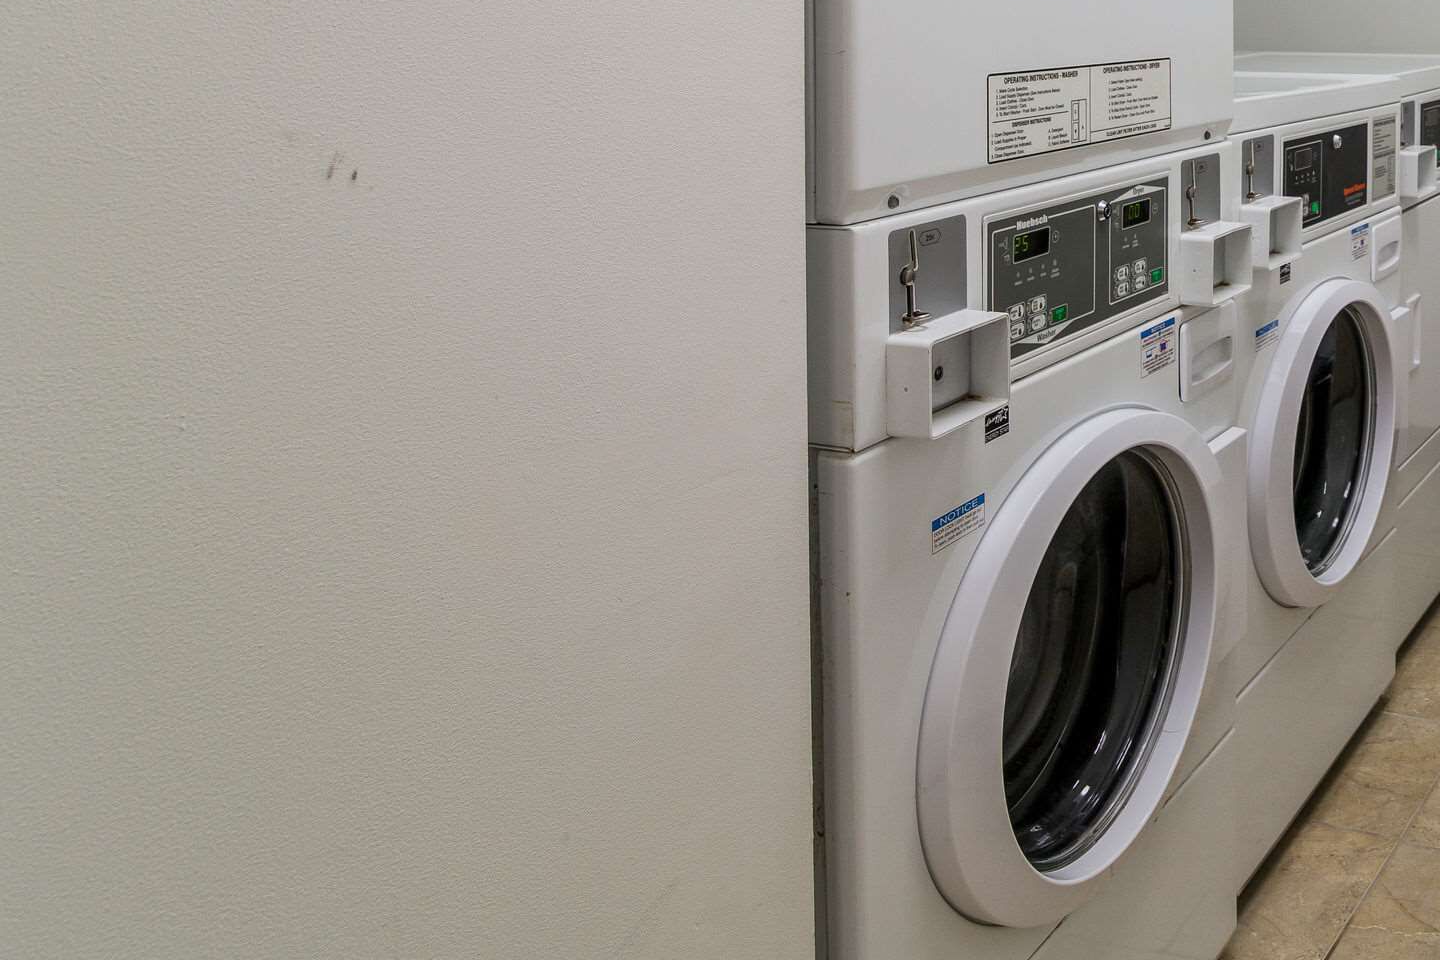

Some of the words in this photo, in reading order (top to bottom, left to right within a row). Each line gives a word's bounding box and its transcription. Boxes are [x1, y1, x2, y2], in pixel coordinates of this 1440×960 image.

[1016, 214, 1048, 230] Huebsch
[1036, 328, 1057, 342] Washer
[939, 498, 979, 526] NOTICE
